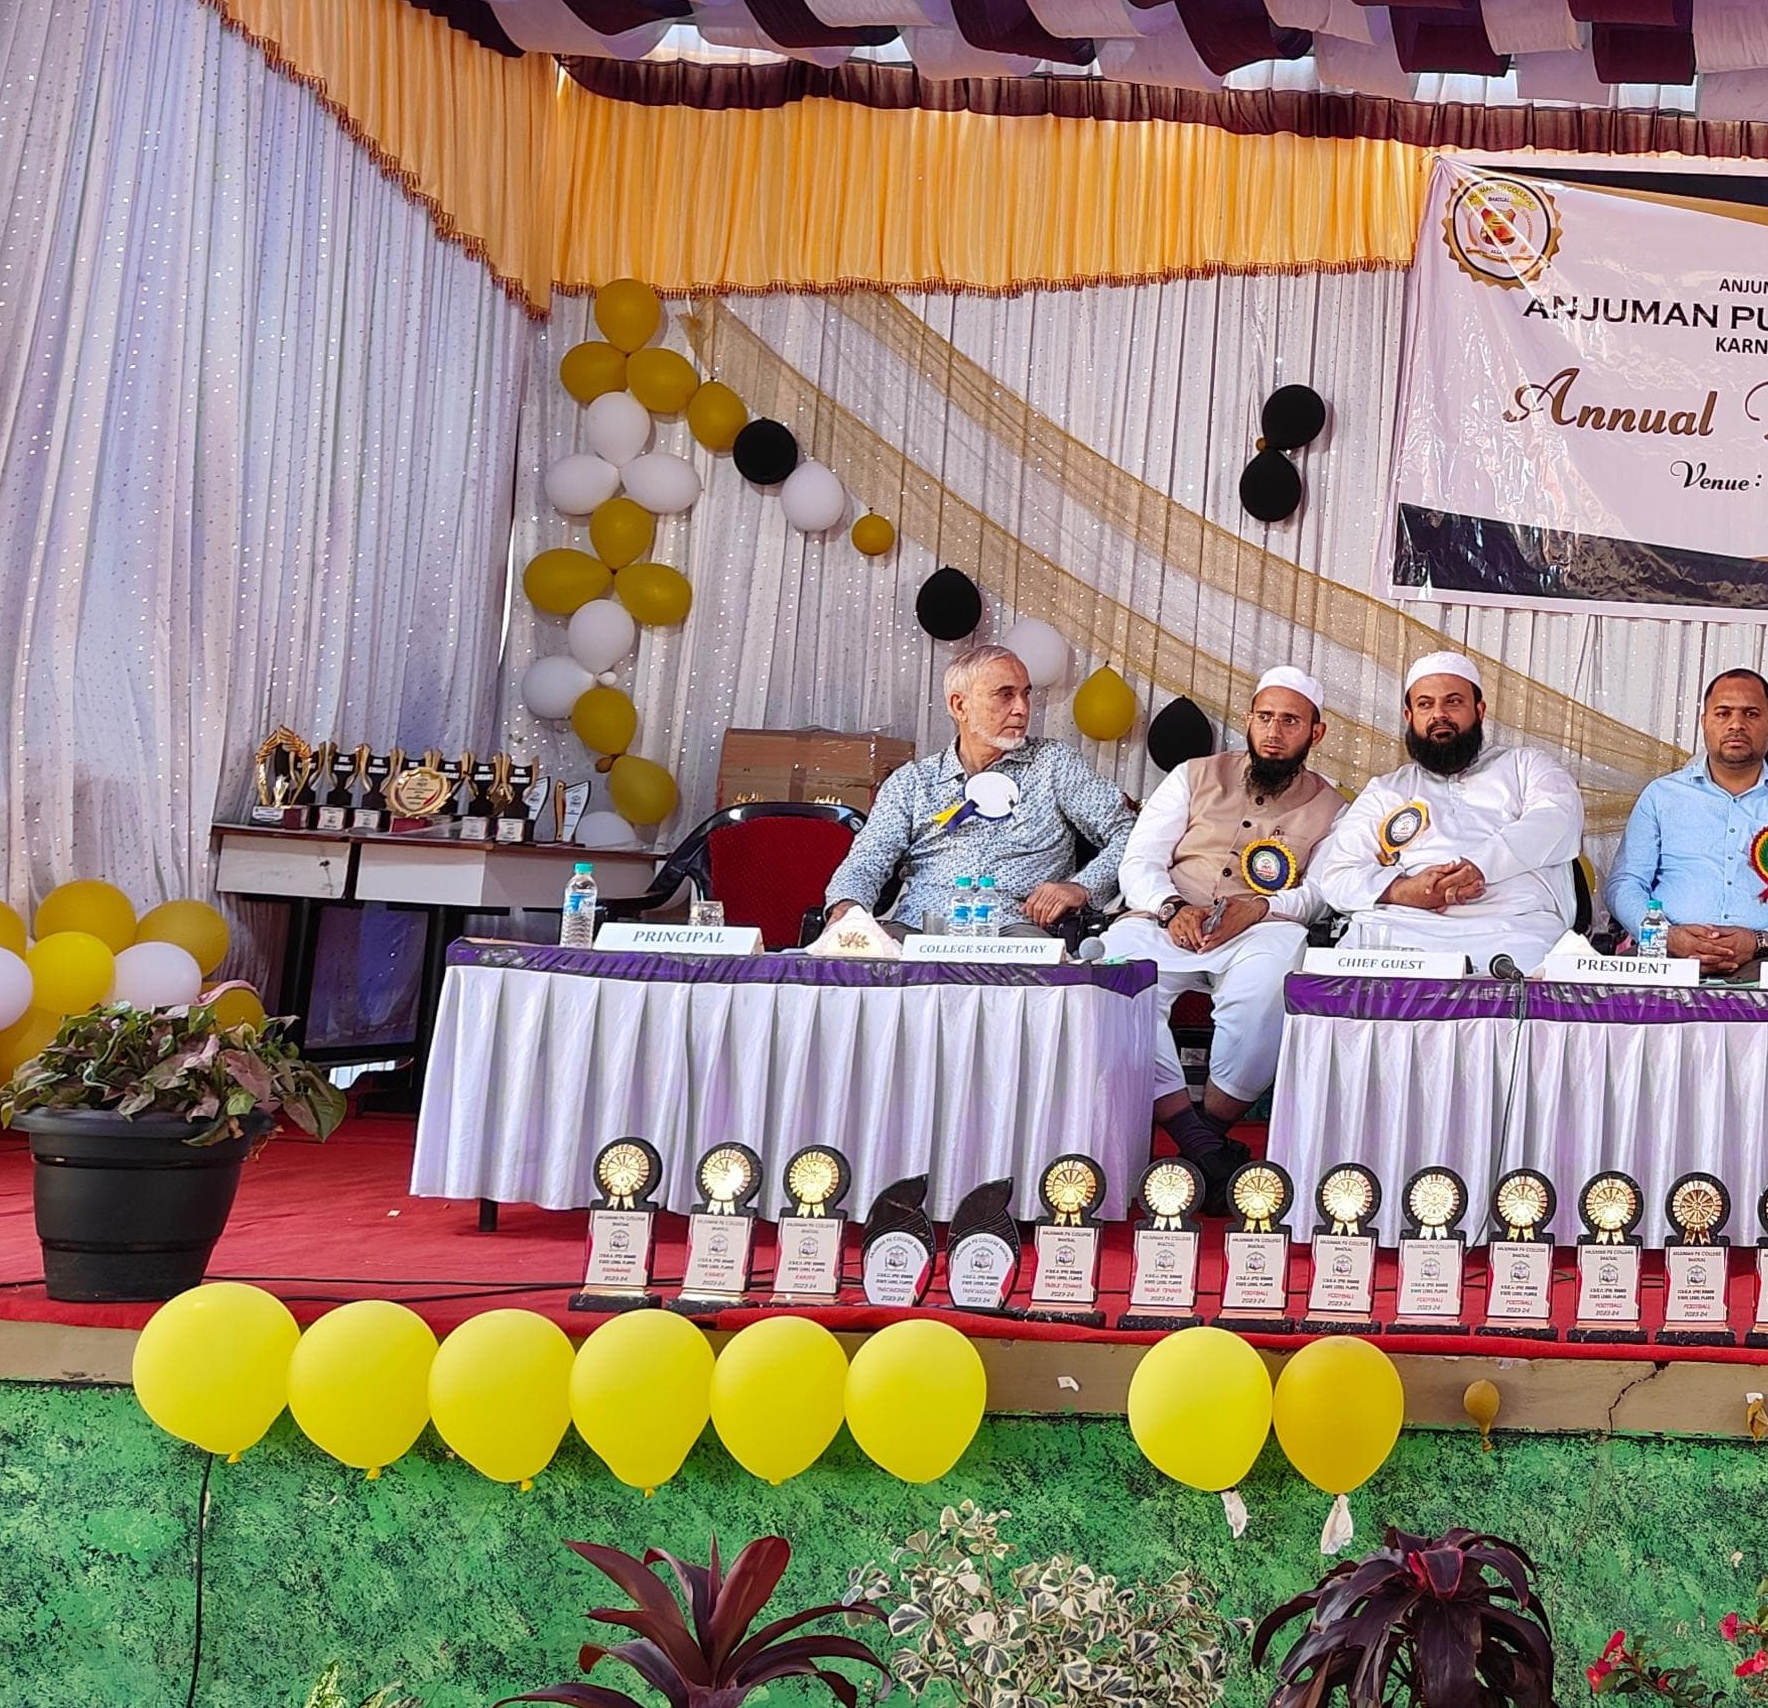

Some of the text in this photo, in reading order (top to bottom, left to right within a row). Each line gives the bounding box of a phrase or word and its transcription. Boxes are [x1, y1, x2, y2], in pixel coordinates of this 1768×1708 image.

[1523, 295, 1718, 328] ANJUMAN
[1502, 367, 1718, 436] Annual
[1670, 460, 1750, 491] Venue
[633, 929, 725, 944] PRINCIPAL
[919, 943, 1048, 955] COLLEGE SECRETARY
[1337, 957, 1426, 972] CHIEF GUEST
[1576, 958, 1672, 976] PRESIDENT
